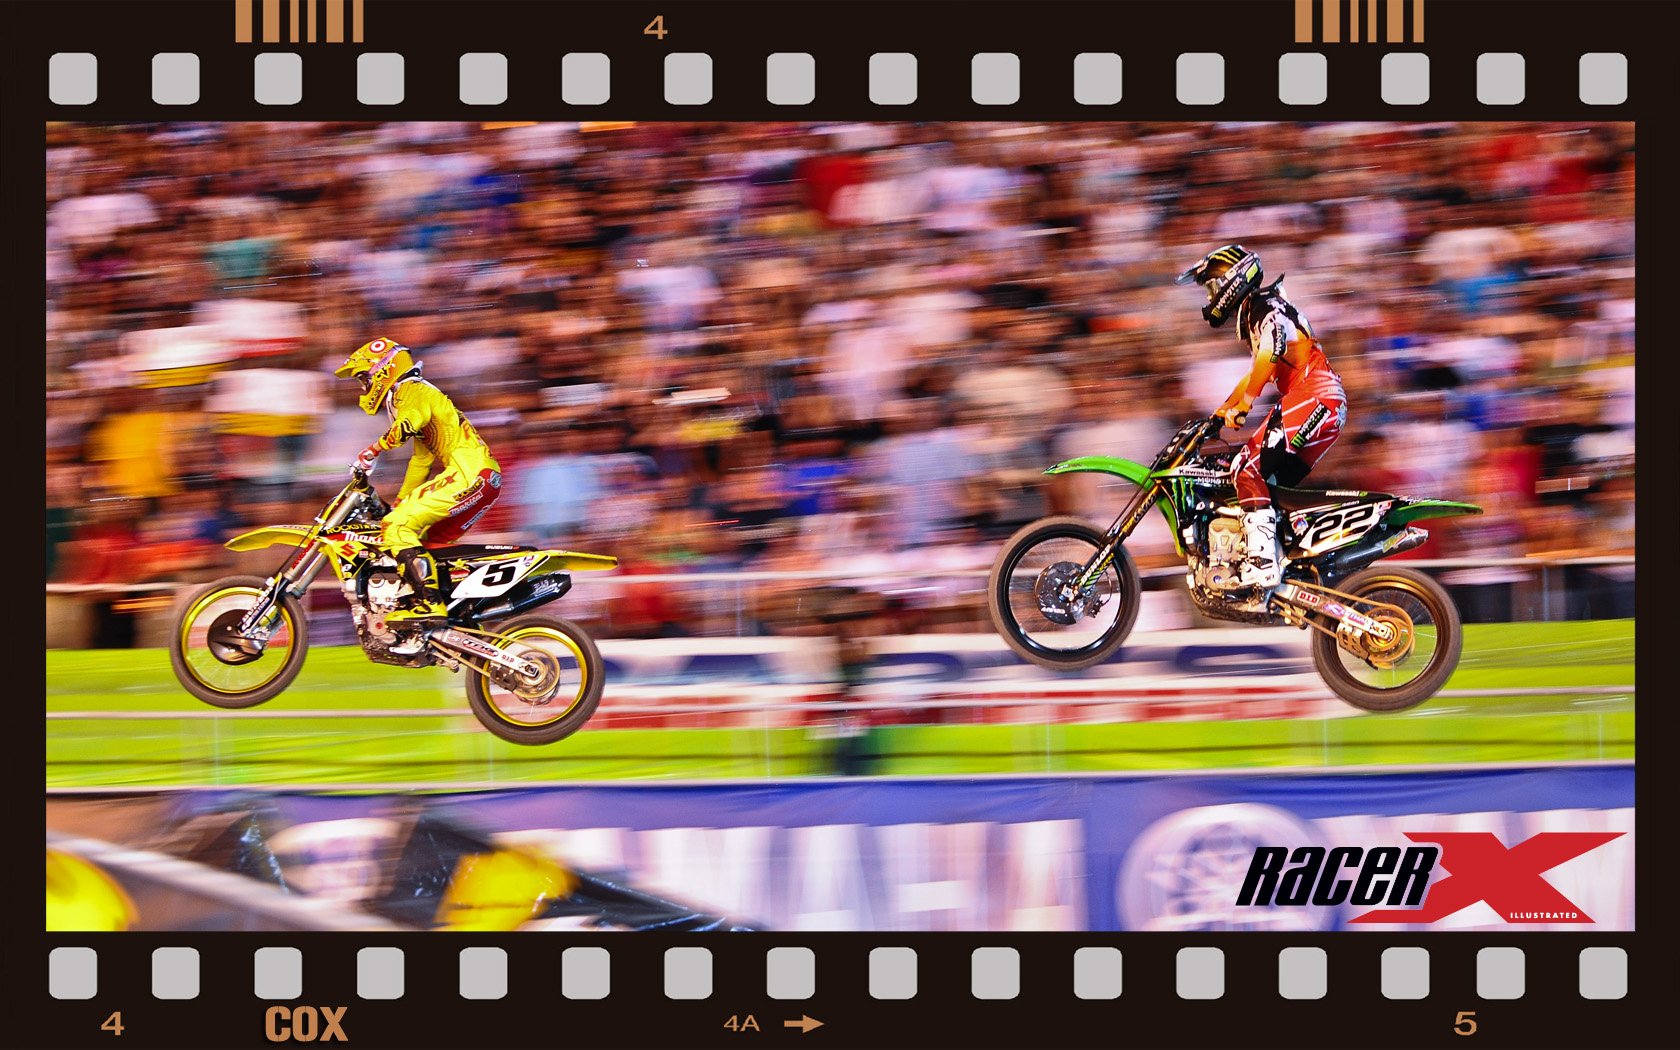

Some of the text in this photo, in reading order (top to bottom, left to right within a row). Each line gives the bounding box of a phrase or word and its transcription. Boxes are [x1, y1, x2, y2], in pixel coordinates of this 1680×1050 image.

[1299, 403, 1325, 434] MONSTER
[1179, 469, 1216, 477] Kawasaki
[1311, 506, 1375, 548] 22
[481, 558, 519, 587] 5
